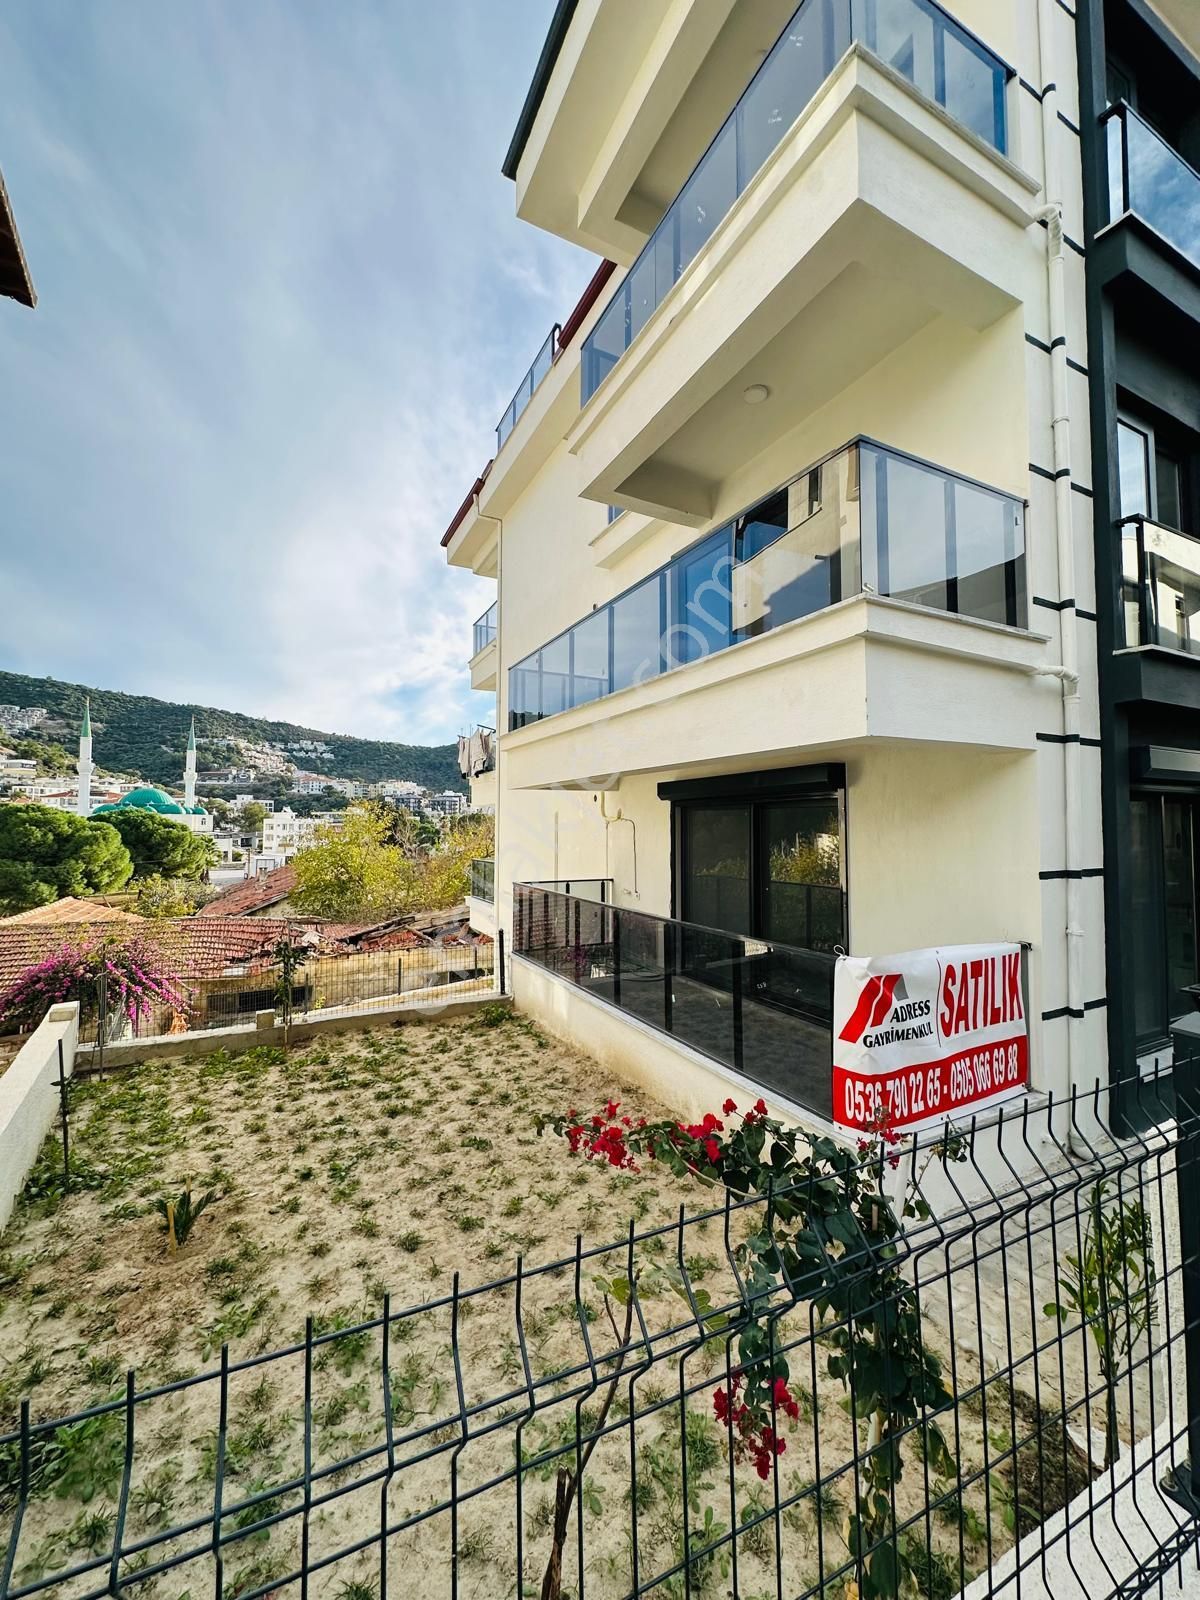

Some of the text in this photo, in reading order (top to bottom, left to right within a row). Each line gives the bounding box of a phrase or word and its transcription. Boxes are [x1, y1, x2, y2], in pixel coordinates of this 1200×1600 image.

[890, 999, 931, 1023] ADRESS
[940, 952, 1023, 1038] SATILIK
[862, 1021, 934, 1049] GAYRİMENKUL
[845, 1043, 1018, 1122] 0536 790 22 65 - 0505 066 69 88
